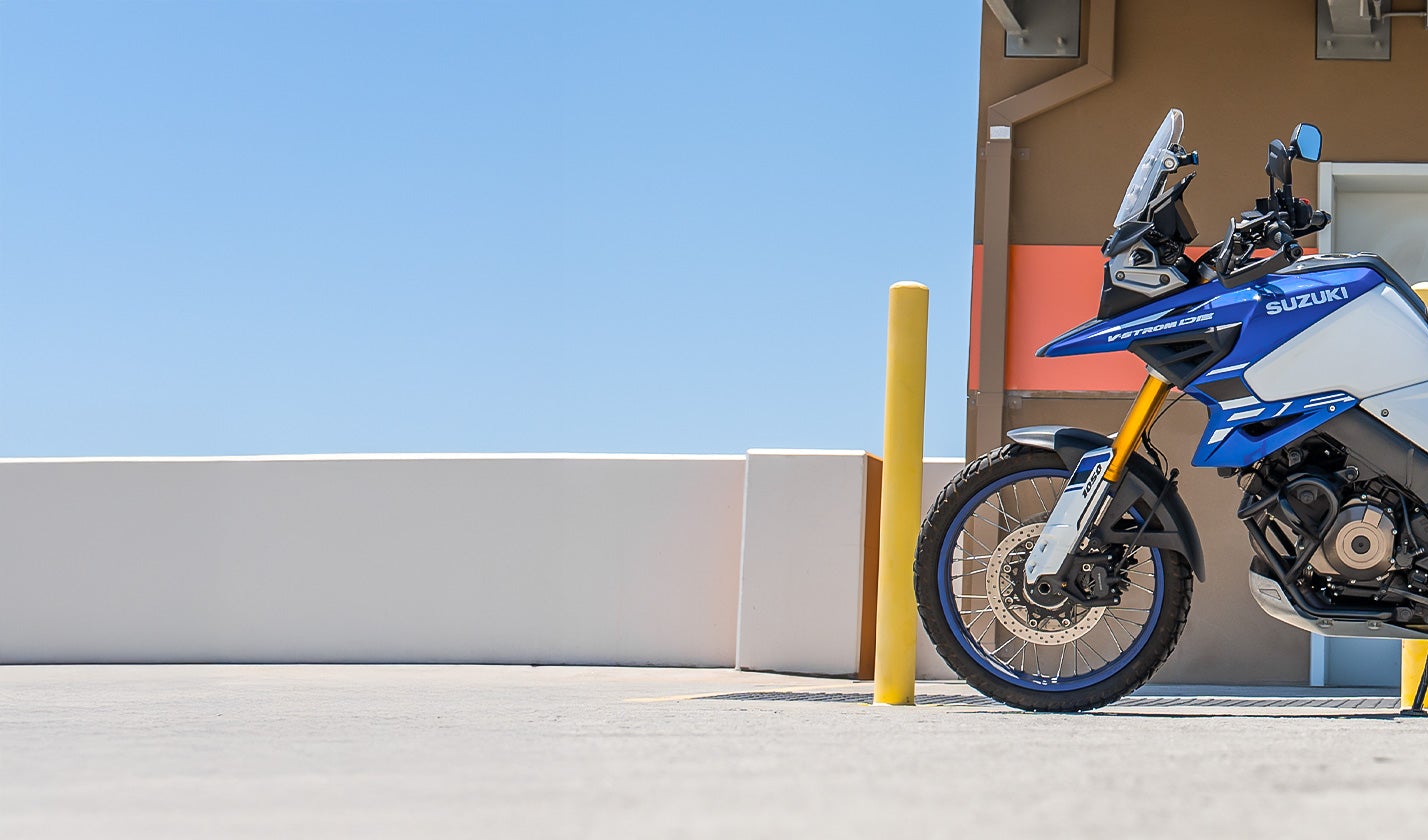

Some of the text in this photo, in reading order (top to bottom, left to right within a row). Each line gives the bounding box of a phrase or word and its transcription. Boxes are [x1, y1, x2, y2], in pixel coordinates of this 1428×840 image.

[1265, 286, 1349, 315] SUZUKI
[1107, 321, 1178, 343] V-STROM
[1082, 463, 1102, 499] 1050
